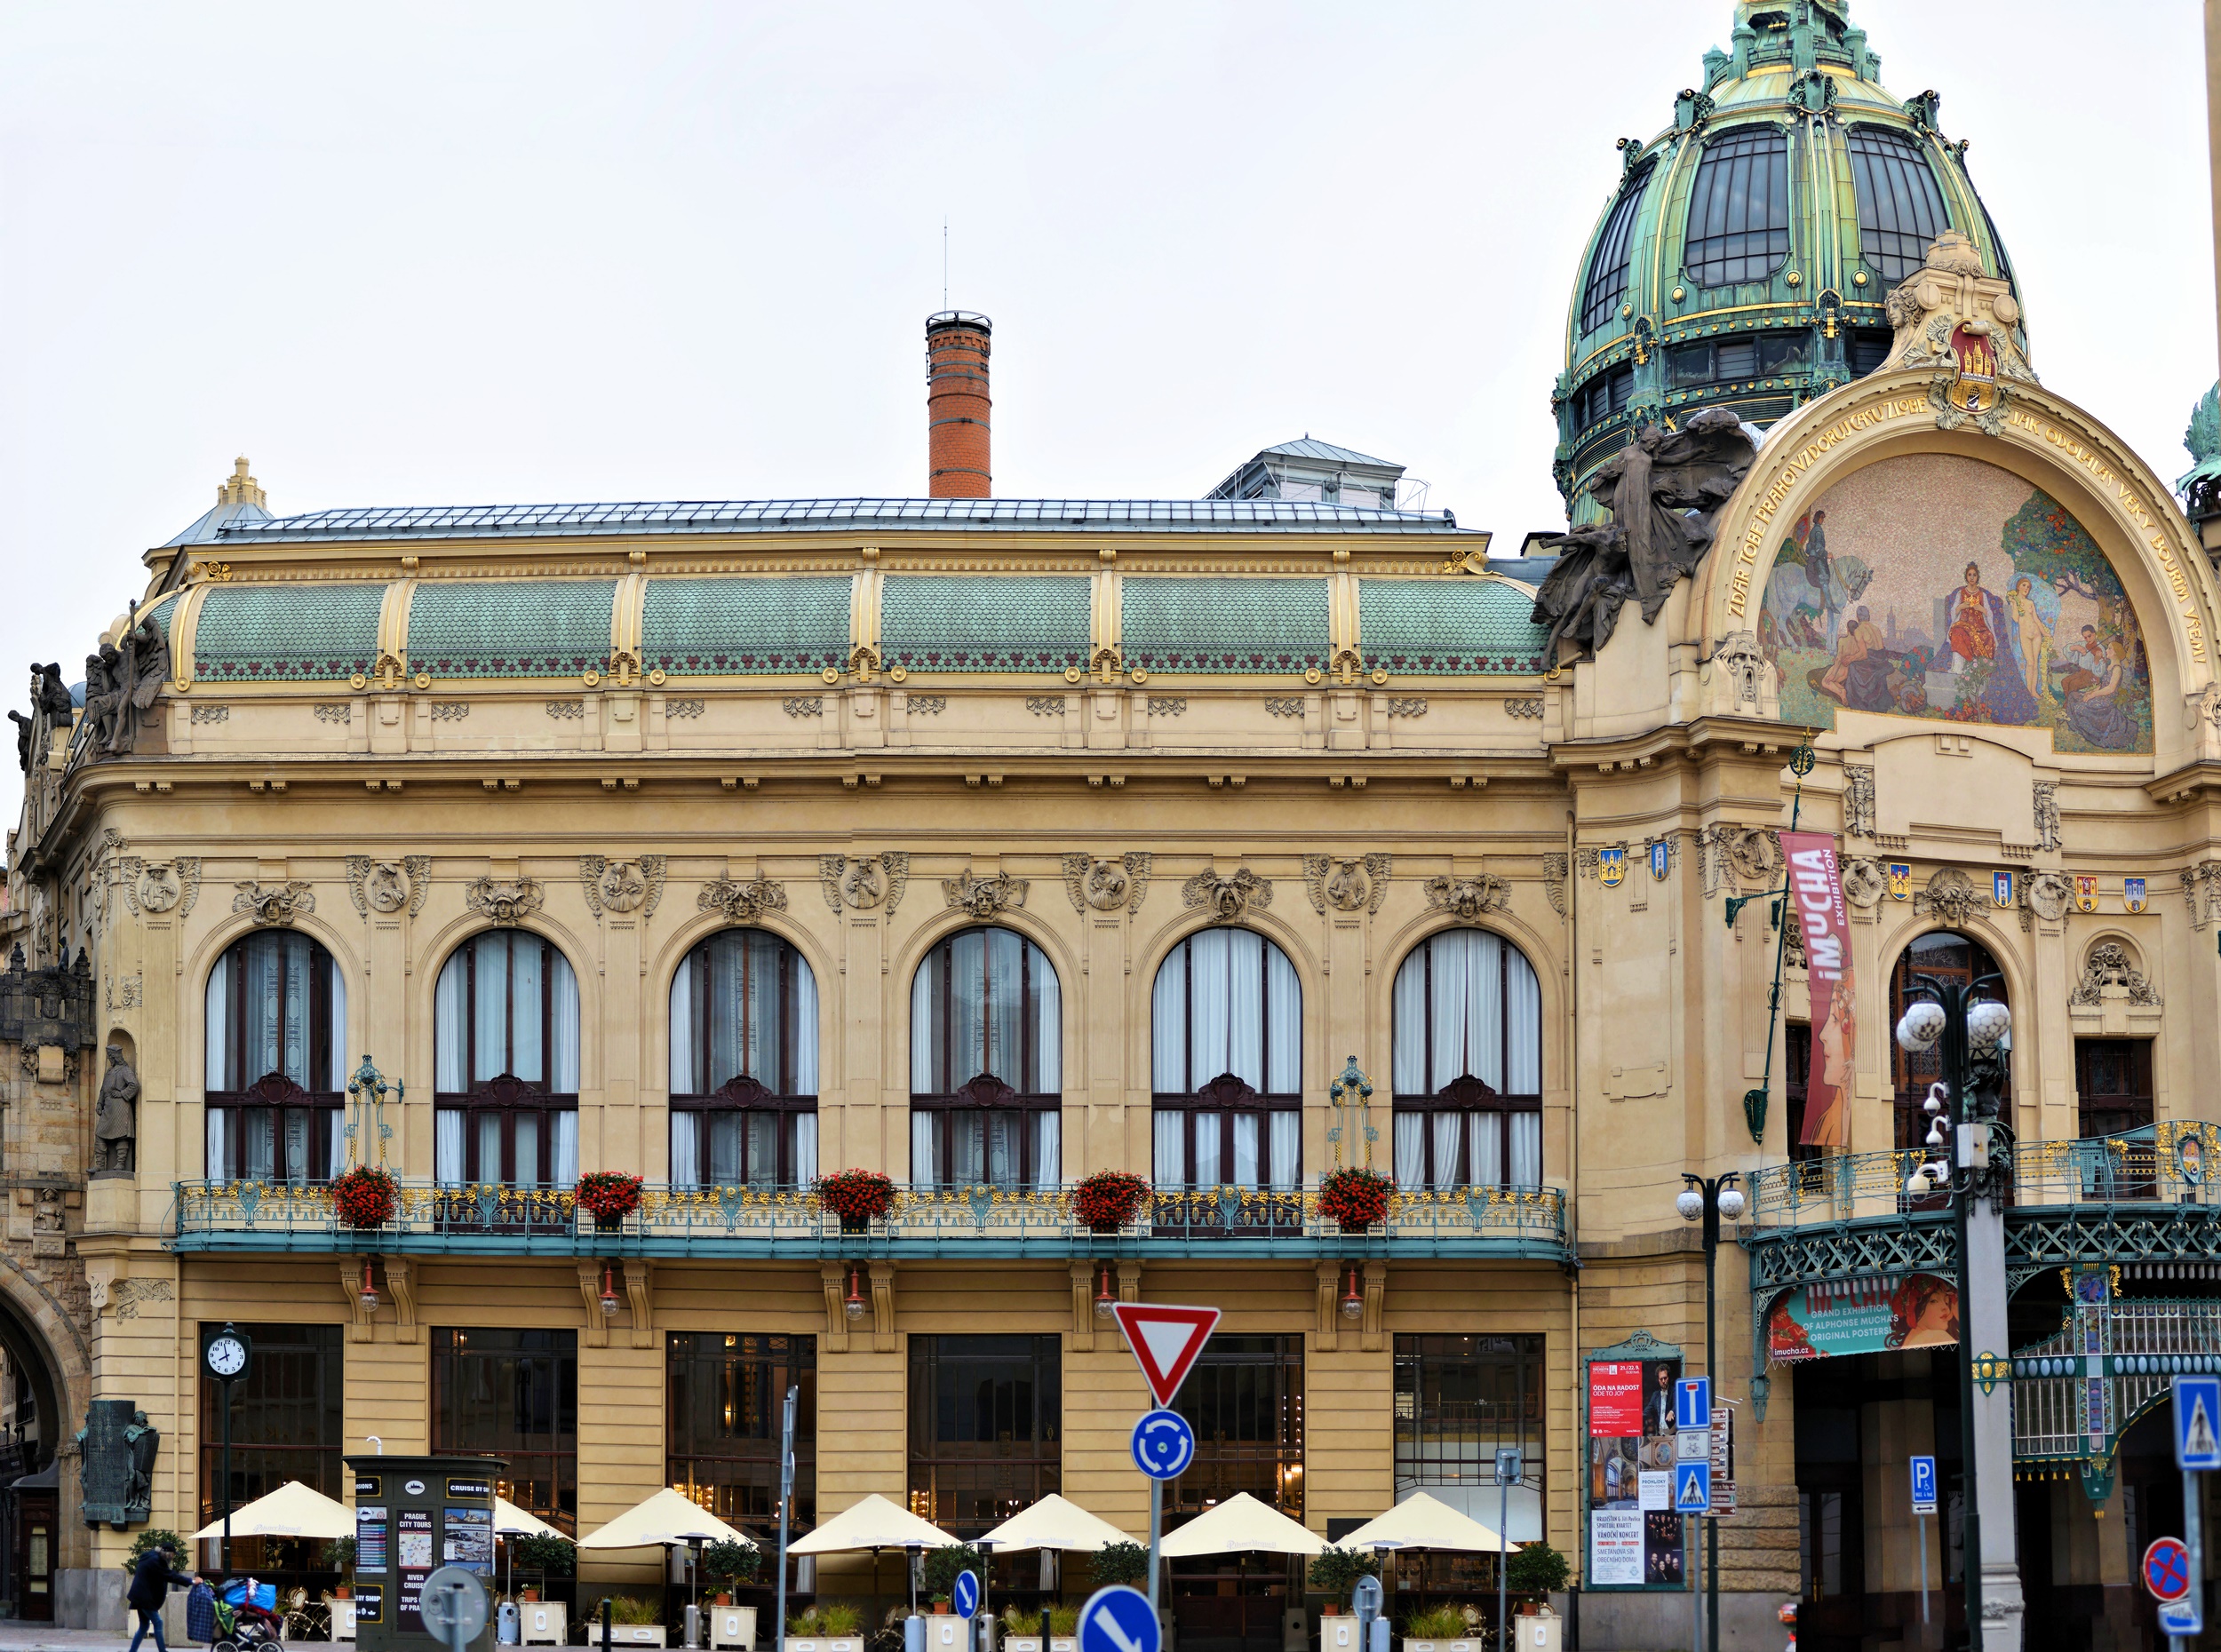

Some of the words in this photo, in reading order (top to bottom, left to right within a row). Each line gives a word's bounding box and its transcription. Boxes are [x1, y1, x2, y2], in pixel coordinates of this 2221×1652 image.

[1883, 394, 1929, 419] ZLOBĚ
[1790, 421, 1852, 472] VZDORUJ
[1755, 465, 1798, 525] PRAHO!
[1737, 517, 1766, 566] TOBĚ
[2009, 410, 2042, 436] JAK
[2045, 427, 2116, 488] ODOLALAS
[2118, 481, 2155, 530] VĚKY
[2184, 605, 2207, 663] VŠEM!
[1727, 568, 1750, 618] ZDAR
[1823, 848, 1845, 925] EXHIBITION
[245, 1182, 254, 1193] P
[483, 1185, 493, 1195] P
[727, 1187, 736, 1198] P
[976, 1187, 986, 1197] P
[1225, 1187, 1235, 1197] P
[1473, 1187, 1483, 1197] P
[1811, 1308, 1841, 1319] GRAND
[1843, 1304, 1889, 1316] EXHIBITION
[1803, 1322, 1814, 1331] OF
[1815, 1319, 1859, 1330] ALPHONSE
[1860, 1314, 1899, 1325] MUCHA'S
[1810, 1330, 1851, 1342] ORIGINAL
[1852, 1326, 1892, 1338] POSTERS!
[1774, 1346, 1809, 1356] imucha.cz
[1916, 1462, 1930, 1489] P
